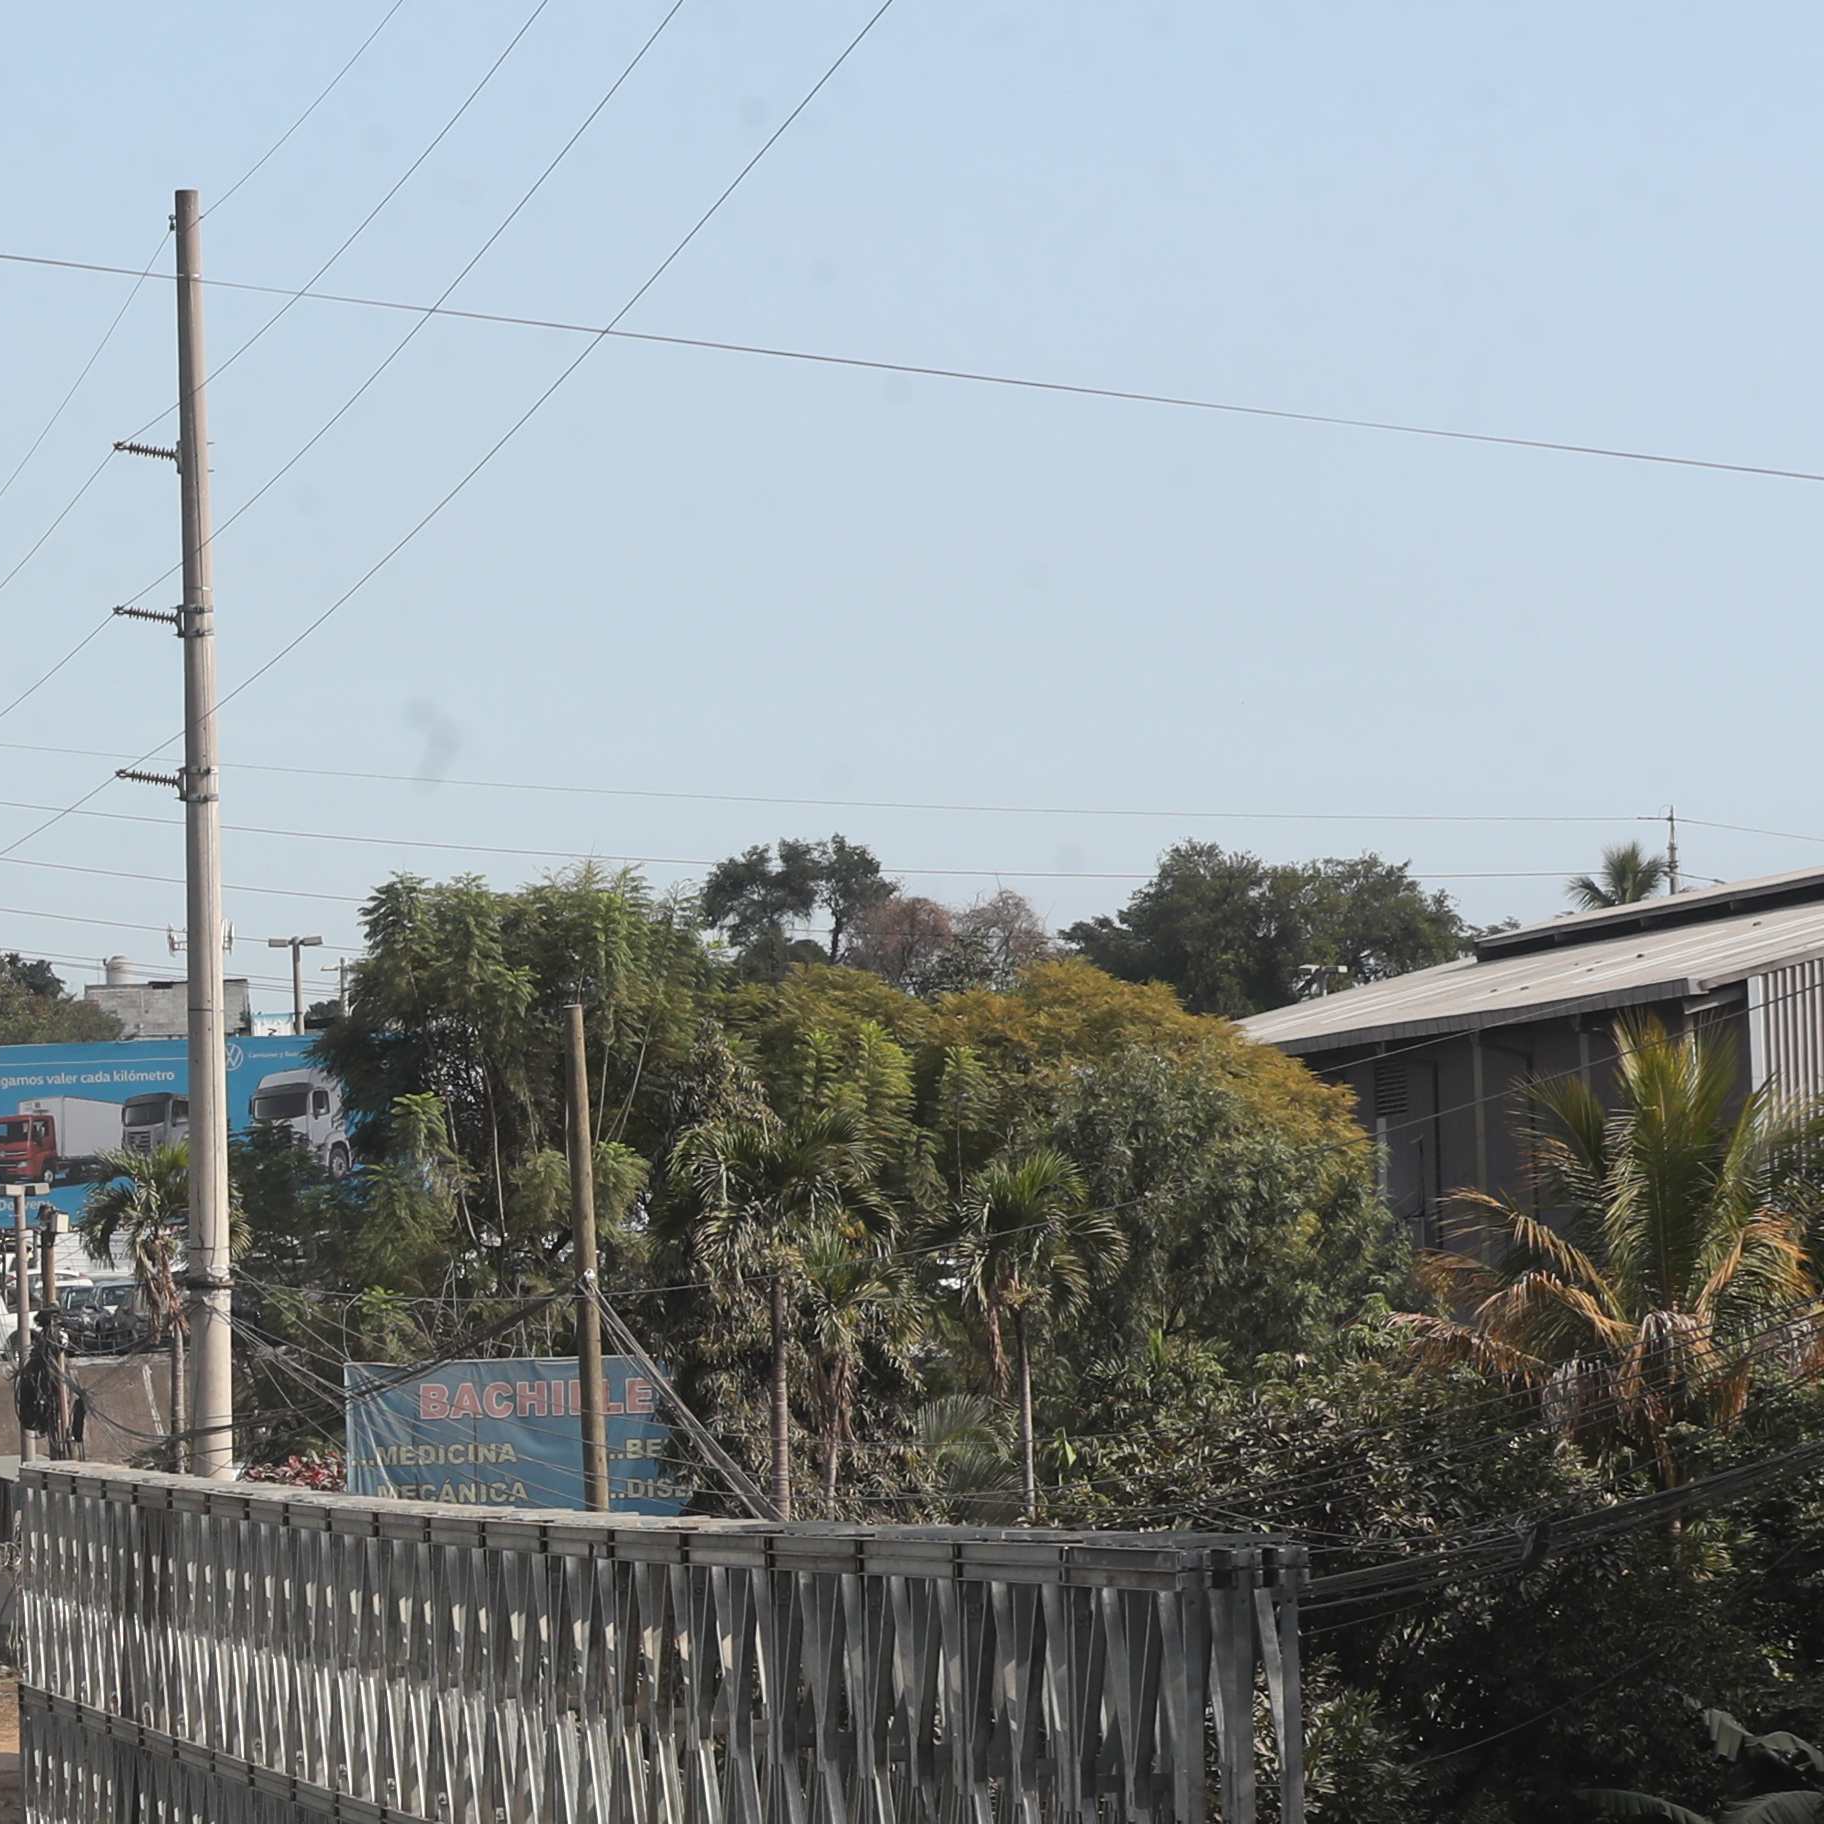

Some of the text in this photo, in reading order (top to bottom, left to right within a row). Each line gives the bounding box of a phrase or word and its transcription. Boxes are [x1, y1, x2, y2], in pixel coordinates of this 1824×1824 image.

[46, 1073, 77, 1085] valer
[80, 1071, 111, 1083] cada
[113, 1070, 176, 1083] kilómetro
